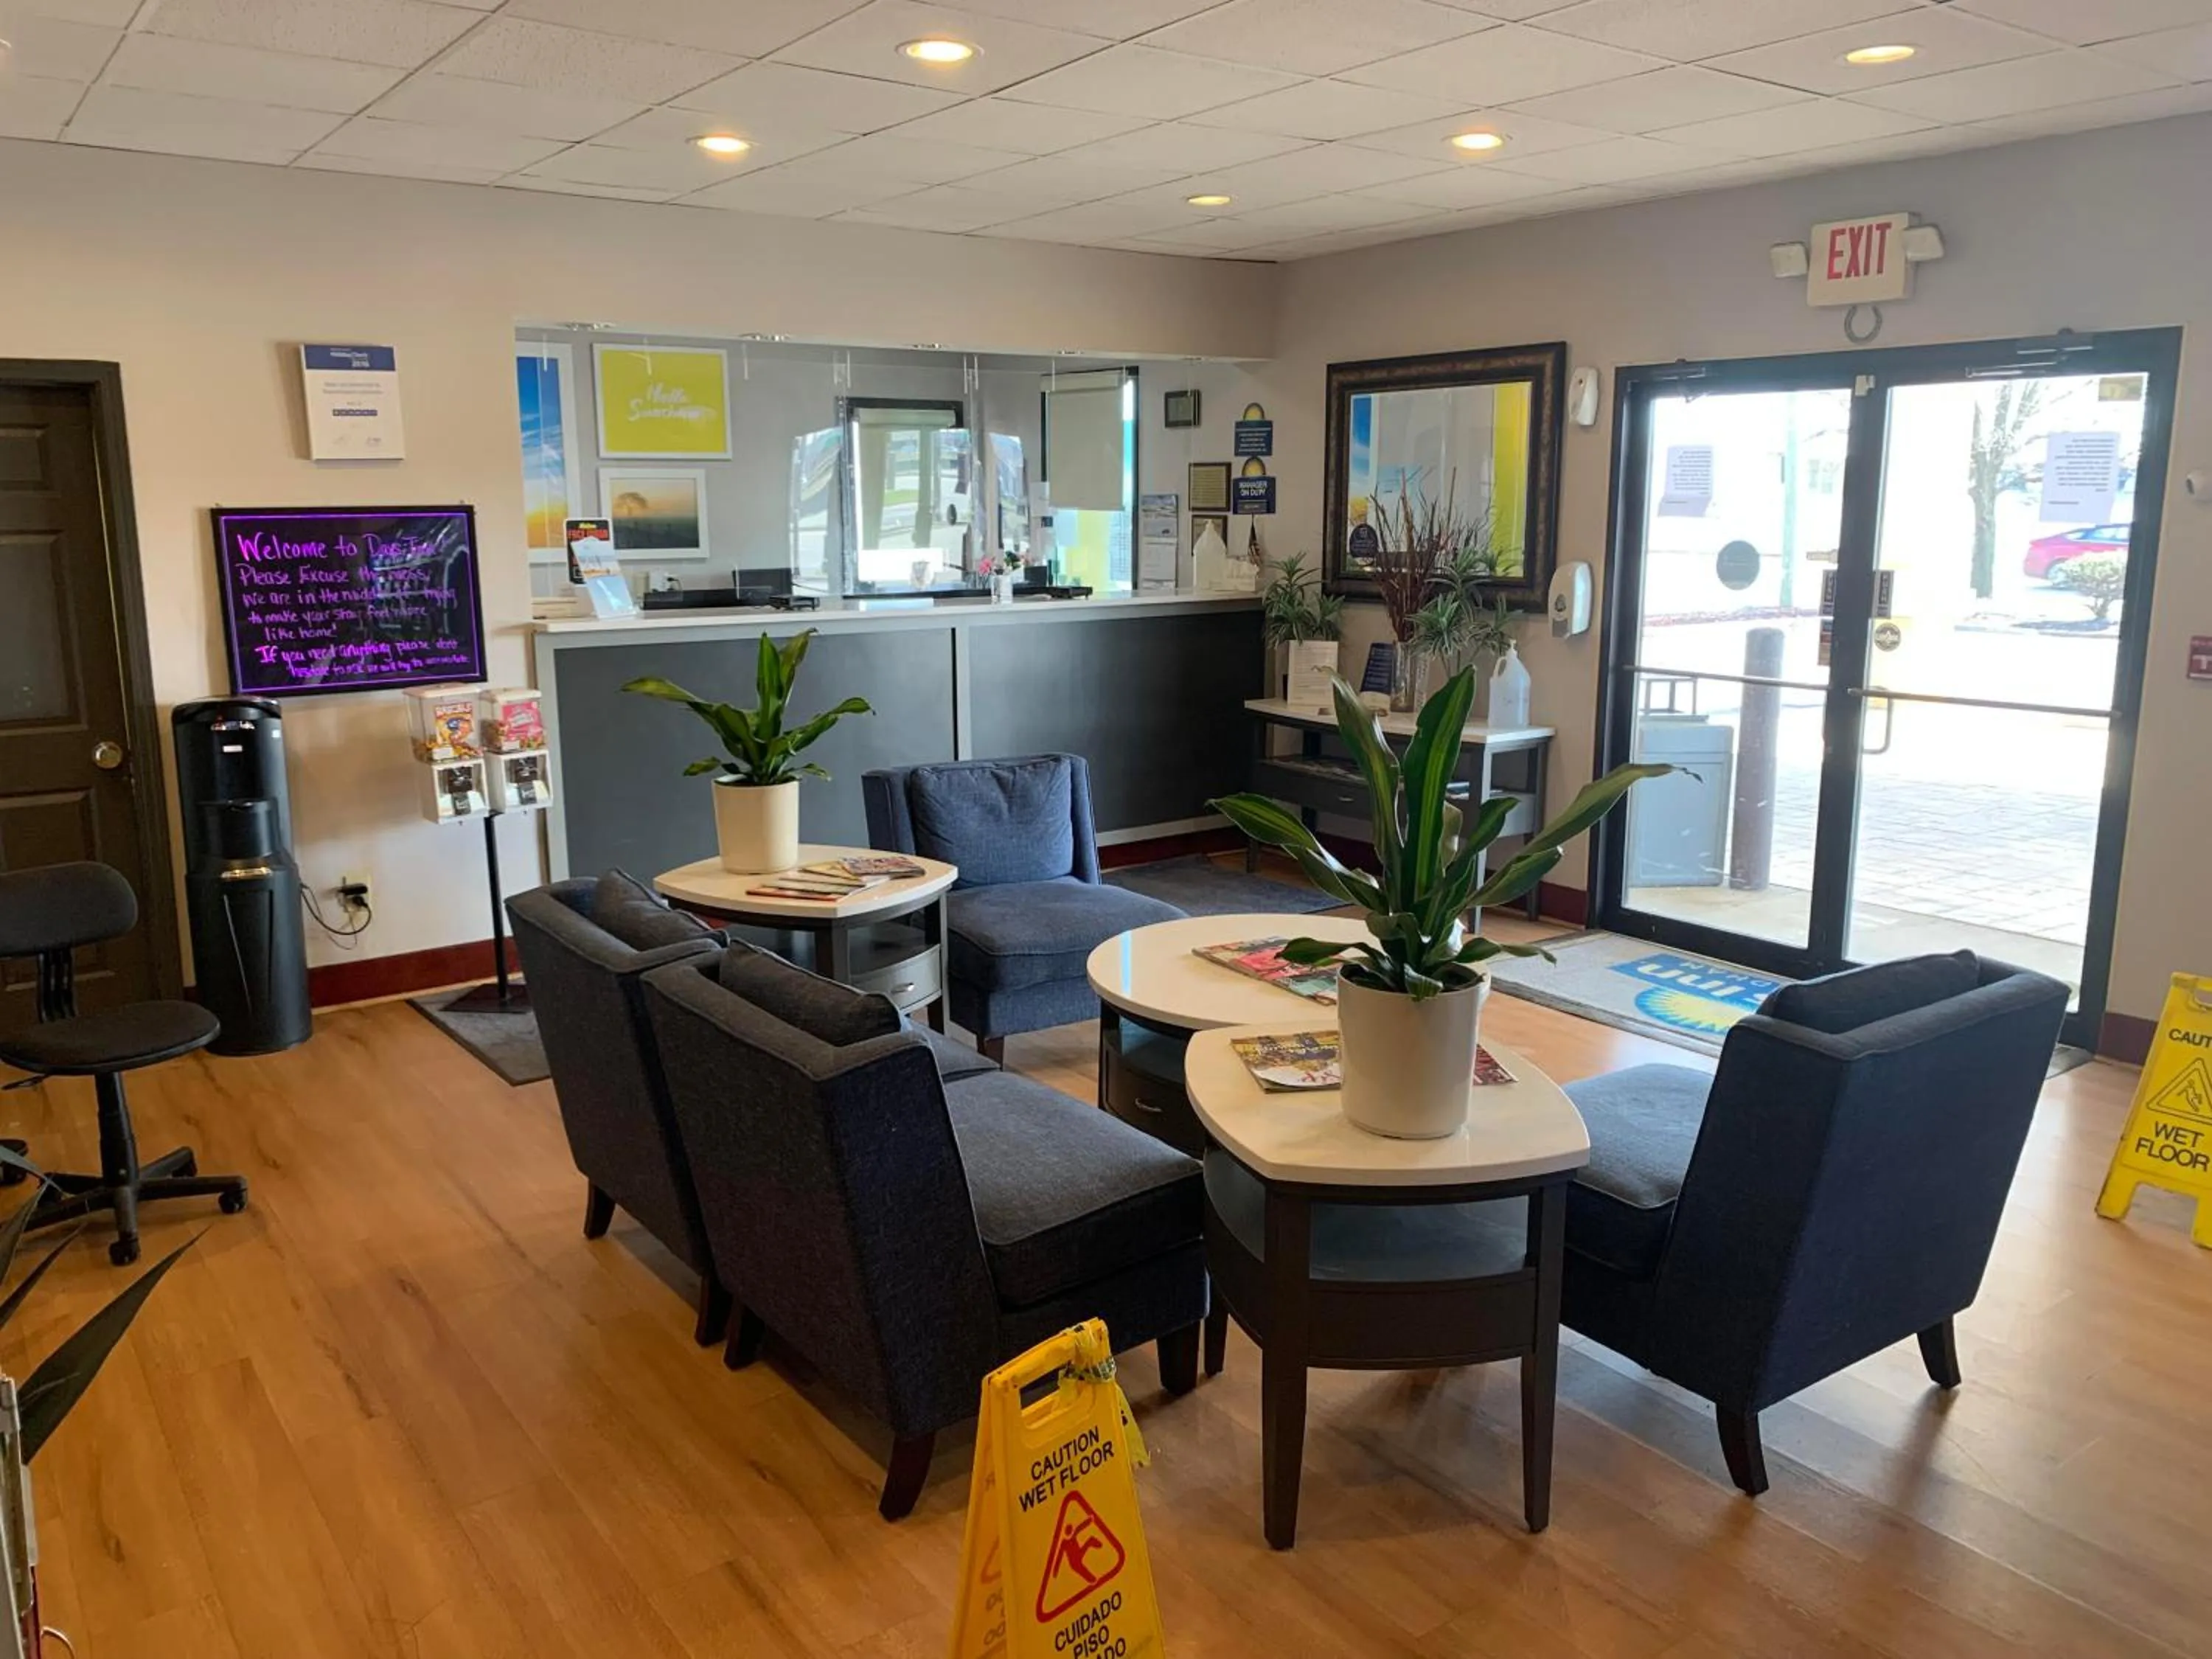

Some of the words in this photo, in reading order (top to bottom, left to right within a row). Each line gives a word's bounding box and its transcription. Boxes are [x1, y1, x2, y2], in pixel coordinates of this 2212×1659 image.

[1827, 222, 1893, 279] EXIT
[1251, 488, 1267, 496] DUTY
[237, 532, 329, 563] Welcome
[333, 534, 358, 556] to
[235, 563, 292, 587] Please
[299, 563, 349, 584] Excuse
[269, 591, 292, 605] are
[298, 589, 317, 604] in
[319, 588, 340, 604] the
[264, 627, 296, 641] like
[254, 644, 279, 663] If
[281, 650, 305, 671] you
[2155, 1120, 2205, 1148] WET
[2135, 1136, 2211, 1172] FLOOR
[1031, 1425, 1099, 1481] CAUTION
[1019, 1476, 1056, 1512] WET
[1060, 1440, 1115, 1489] FLOOR
[1055, 1590, 1121, 1652] CUIDADO
[1073, 1625, 1110, 1659] PISO
